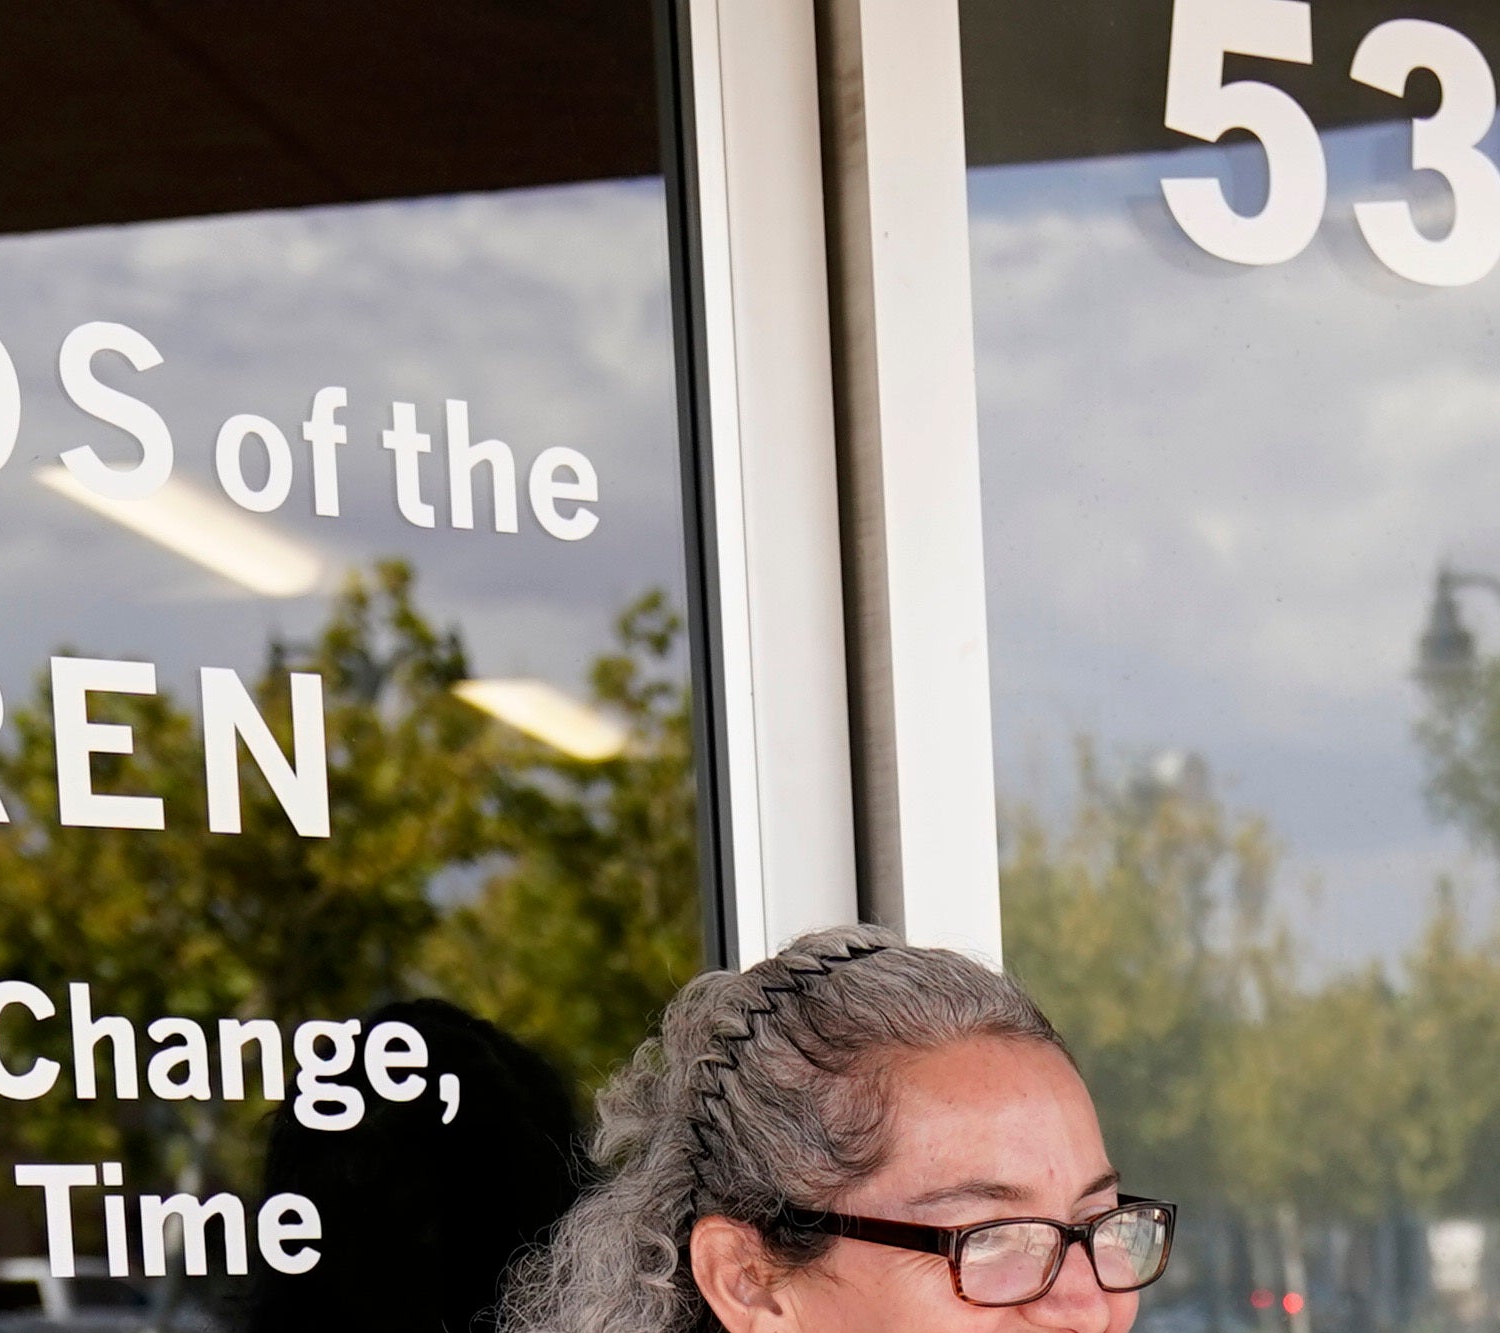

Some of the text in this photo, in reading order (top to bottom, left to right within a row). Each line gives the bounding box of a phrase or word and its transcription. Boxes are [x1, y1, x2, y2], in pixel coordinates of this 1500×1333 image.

[214, 386, 349, 517] of
[382, 399, 601, 542] the
[14, 1162, 324, 1279] Time
